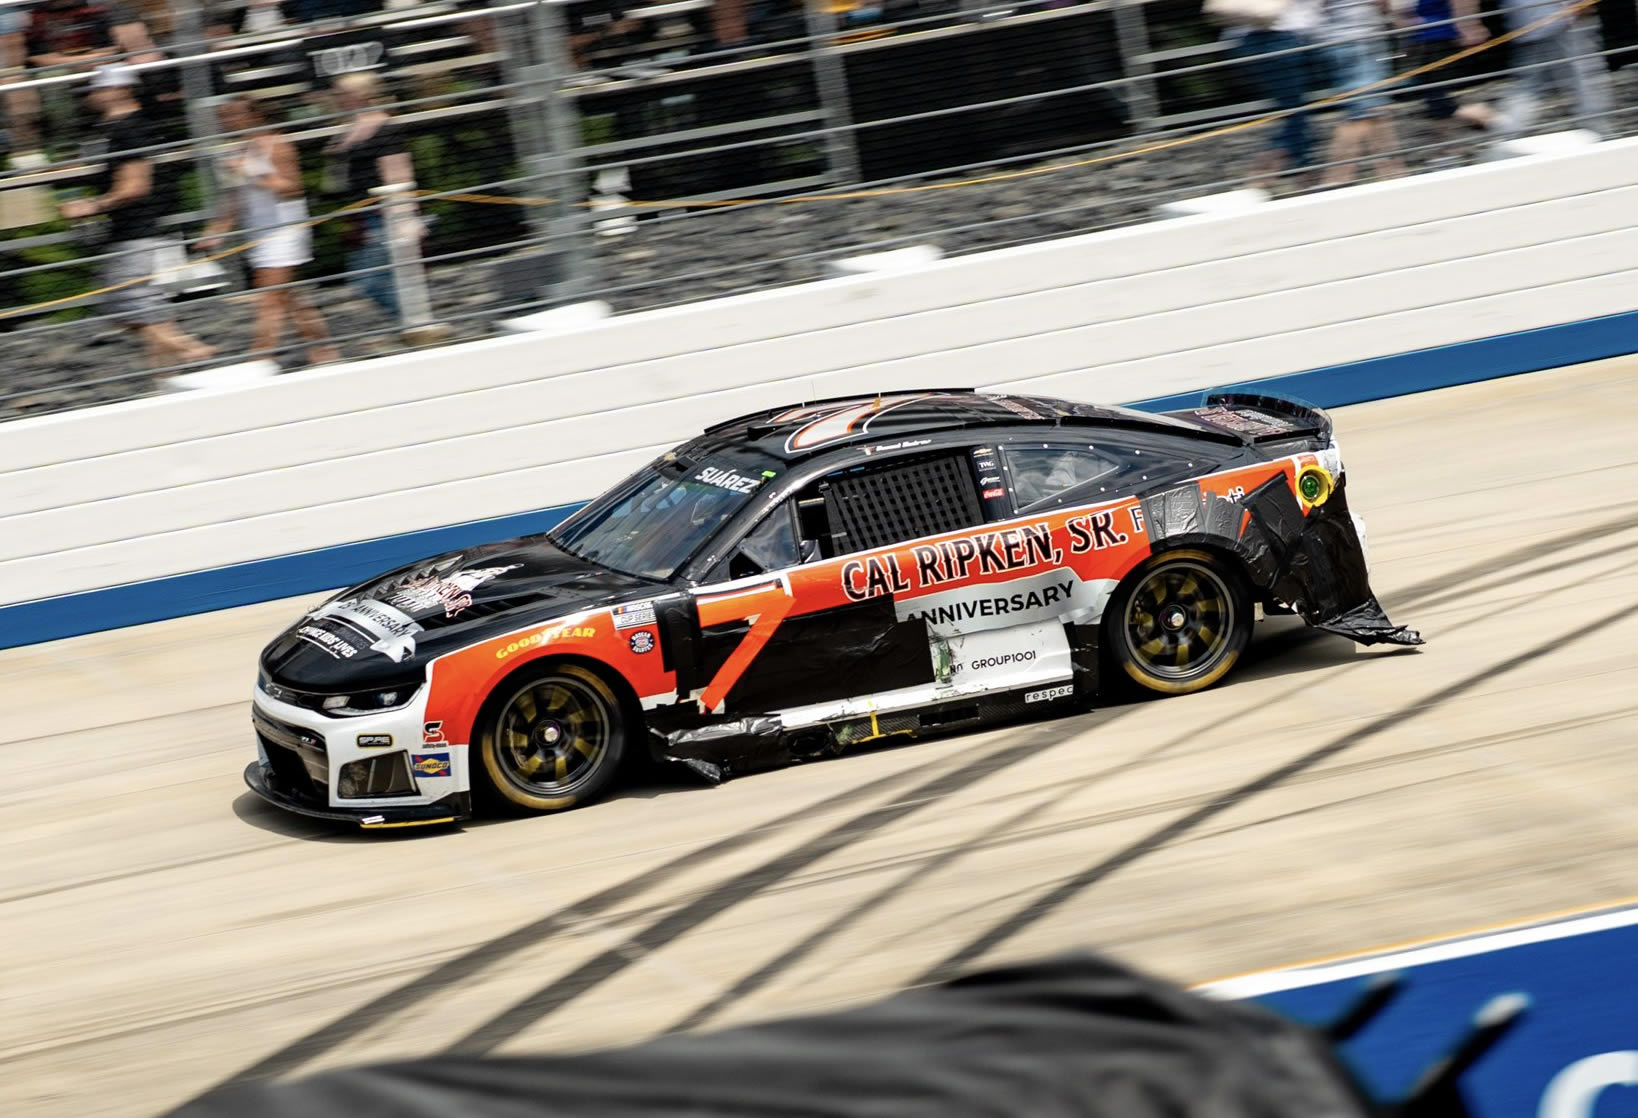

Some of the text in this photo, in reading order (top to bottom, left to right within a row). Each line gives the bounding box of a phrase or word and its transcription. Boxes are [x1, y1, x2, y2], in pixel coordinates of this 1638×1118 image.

[694, 466, 761, 494] SUÁREZ
[841, 553, 910, 602] CAL
[912, 522, 1062, 587] RIPKEN,
[1067, 511, 1128, 554] SR.
[496, 628, 596, 658] GOODYEAR
[971, 650, 1037, 670] GROUP1001
[414, 761, 450, 771] SUNOCO
